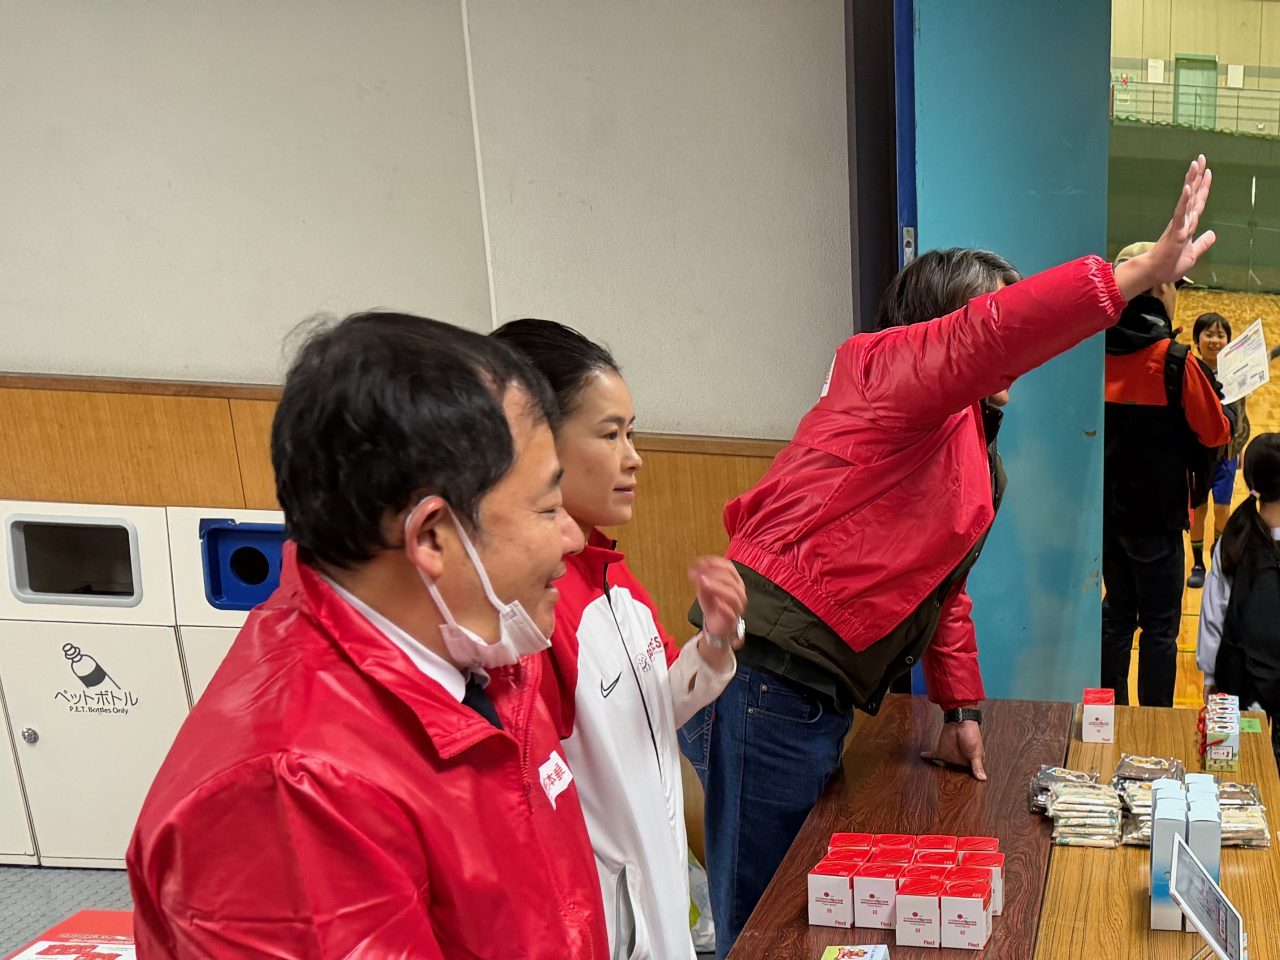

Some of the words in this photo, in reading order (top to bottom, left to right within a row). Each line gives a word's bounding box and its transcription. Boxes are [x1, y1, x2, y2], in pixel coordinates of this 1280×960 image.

[54, 689, 139, 706] ペットボトル
[112, 706, 129, 715] Only
